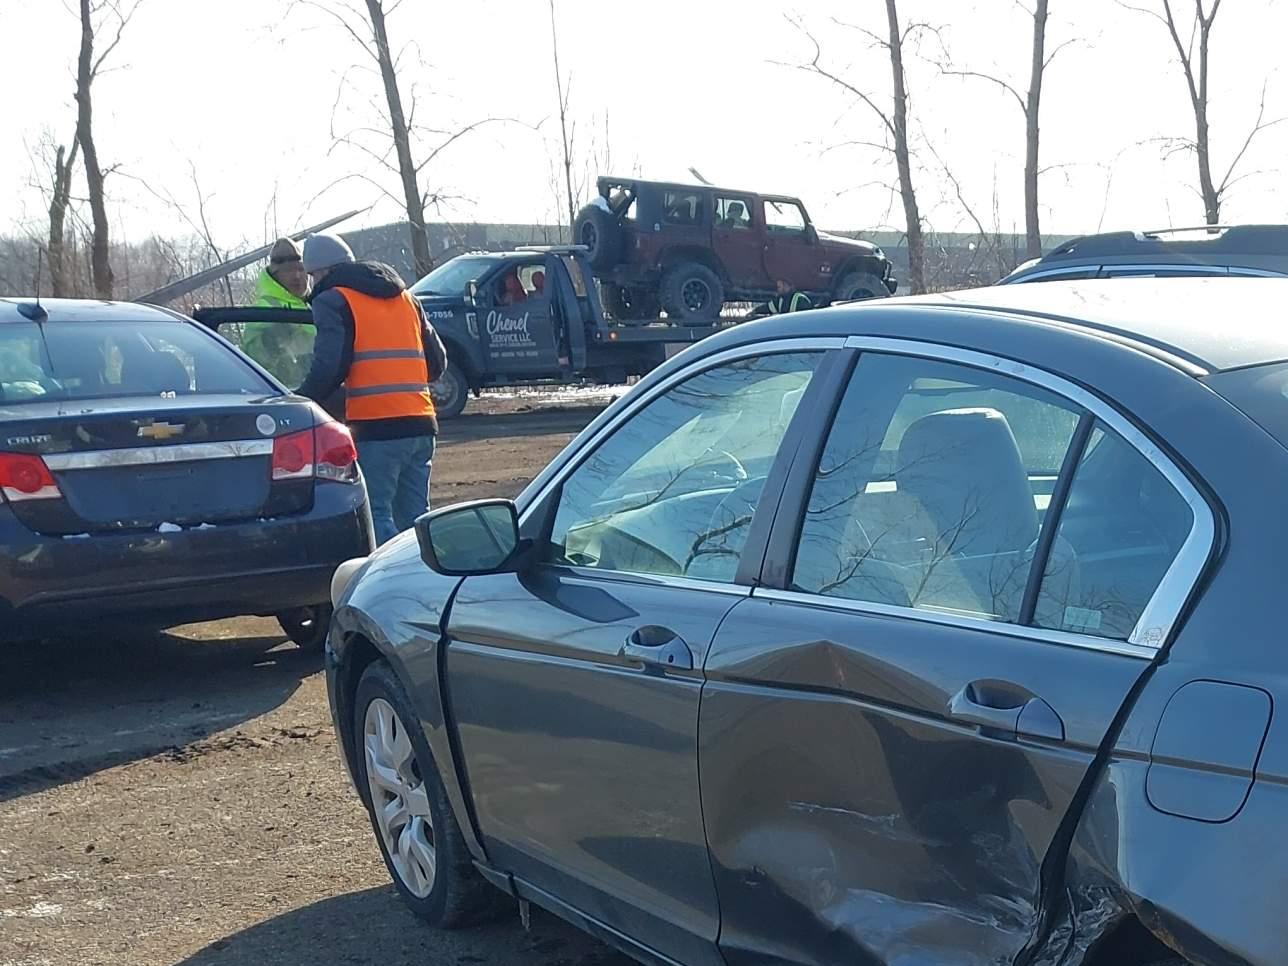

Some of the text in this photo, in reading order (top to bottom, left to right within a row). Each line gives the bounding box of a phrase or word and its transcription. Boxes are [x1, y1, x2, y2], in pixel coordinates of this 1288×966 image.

[486, 310, 529, 335] Chenel
[490, 332, 532, 343] SERVICE LLC
